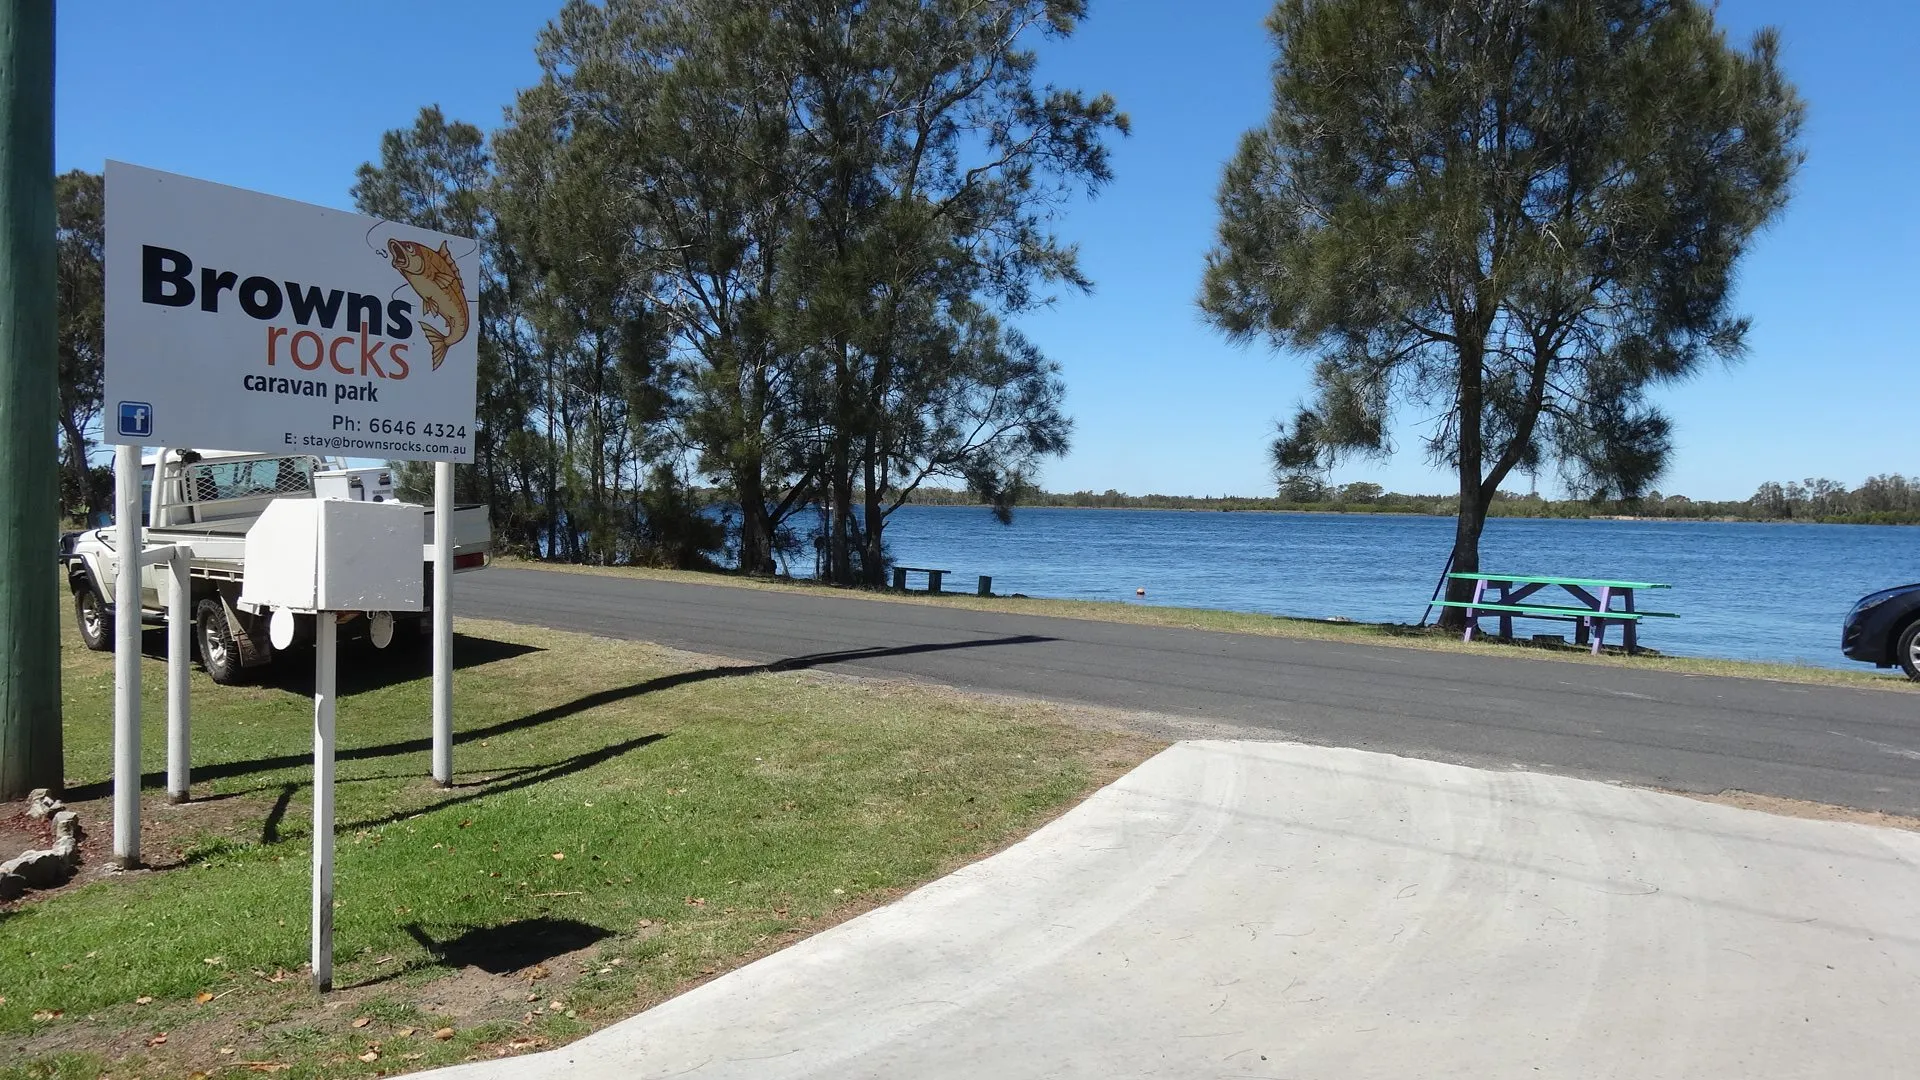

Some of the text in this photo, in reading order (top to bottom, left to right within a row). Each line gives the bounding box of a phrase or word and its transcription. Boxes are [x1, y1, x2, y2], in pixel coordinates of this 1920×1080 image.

[142, 244, 413, 340] Browns
[267, 321, 410, 380] rocks
[243, 373, 379, 404] caravan park
[332, 415, 466, 439] Ph: 6646 4324
[284, 432, 467, 456] E: stay@brownsrocks.com.au
